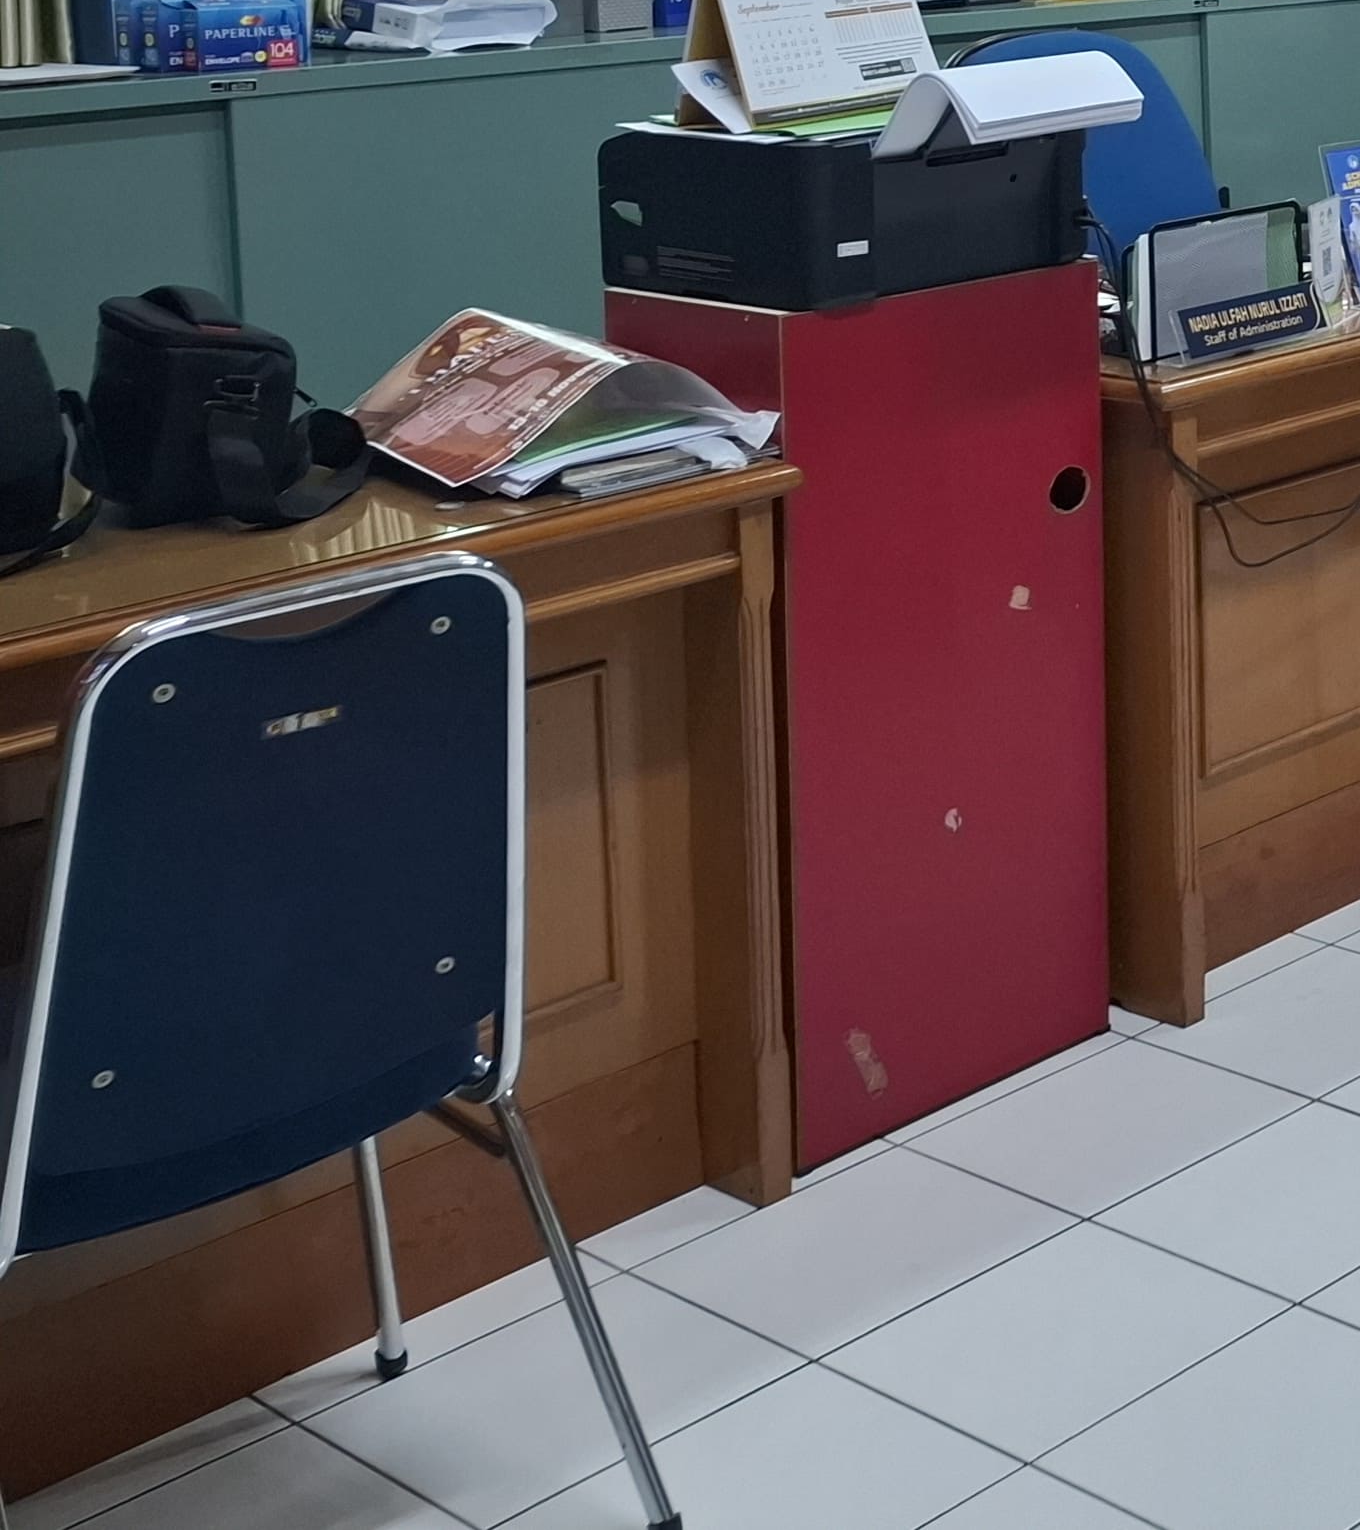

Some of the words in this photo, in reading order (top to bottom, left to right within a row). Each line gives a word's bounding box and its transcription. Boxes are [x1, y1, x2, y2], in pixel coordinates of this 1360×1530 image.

[205, 26, 275, 40] PAPERLINE
[270, 42, 294, 58] 104
[1188, 313, 1221, 334] NADIA
[1218, 306, 1250, 327] ULFAH
[1247, 298, 1281, 320] NURUL
[1278, 292, 1309, 312] IZZATI
[1203, 330, 1227, 346] Staff
[1228, 328, 1239, 341] of
[1240, 315, 1303, 337] Administration
